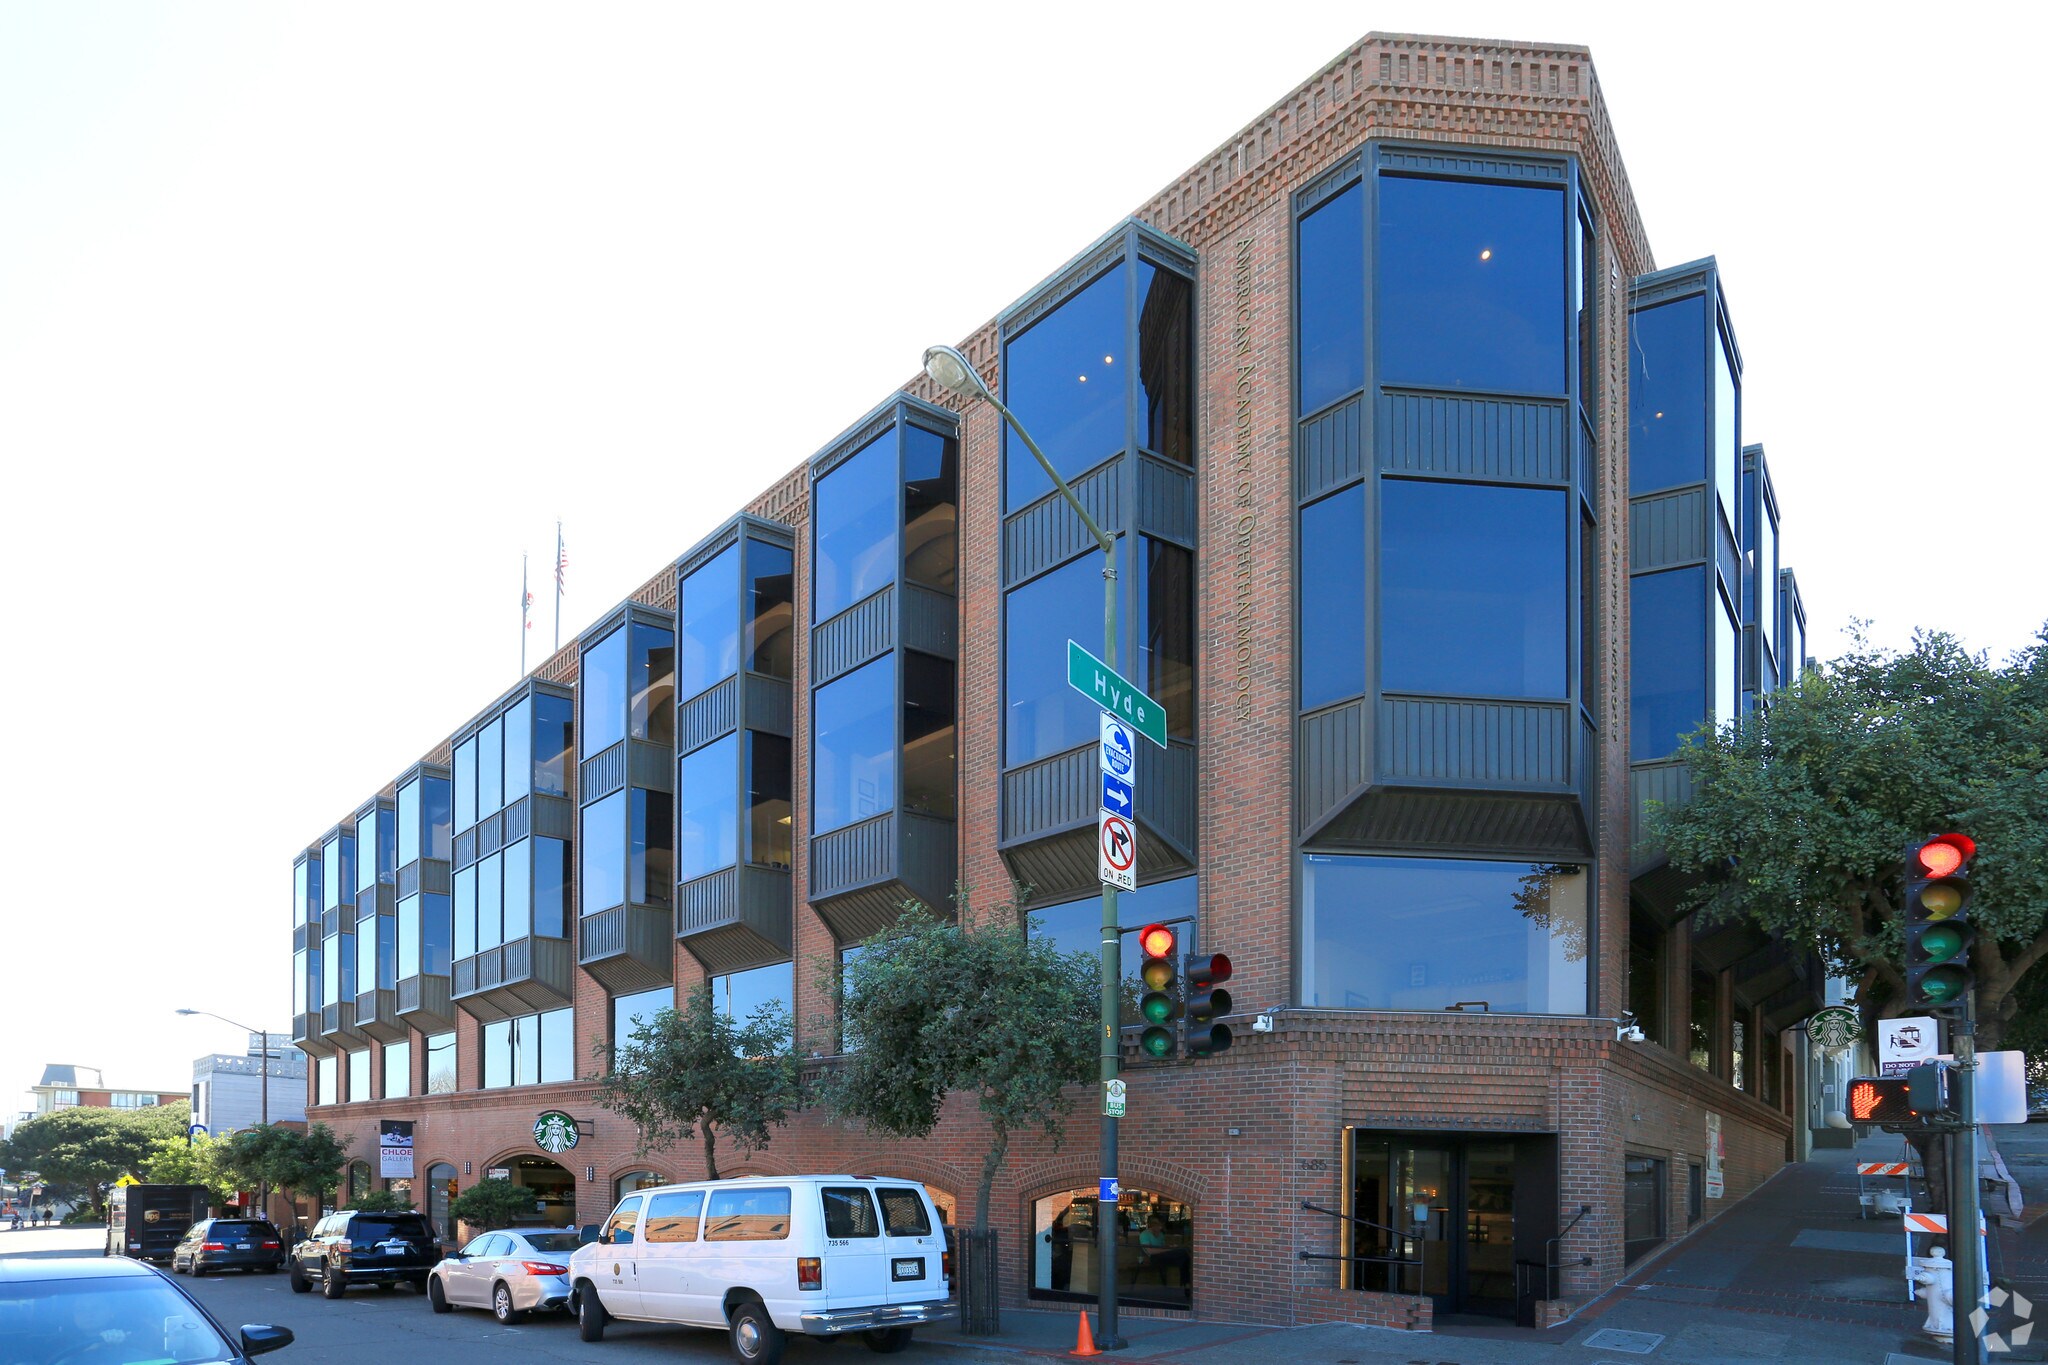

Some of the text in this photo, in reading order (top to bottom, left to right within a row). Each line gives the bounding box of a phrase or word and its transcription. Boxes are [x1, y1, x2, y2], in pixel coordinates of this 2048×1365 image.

[1235, 514, 1256, 722] OPHTHALMOLOGY
[1094, 670, 1145, 723] Hyde
[1105, 745, 1131, 768] EVACUATION
[1111, 758, 1125, 773] ROUTE
[1103, 867, 1132, 886] ON RED
[1108, 1108, 1124, 1116] STOP
[381, 1148, 413, 1156] CHLOE
